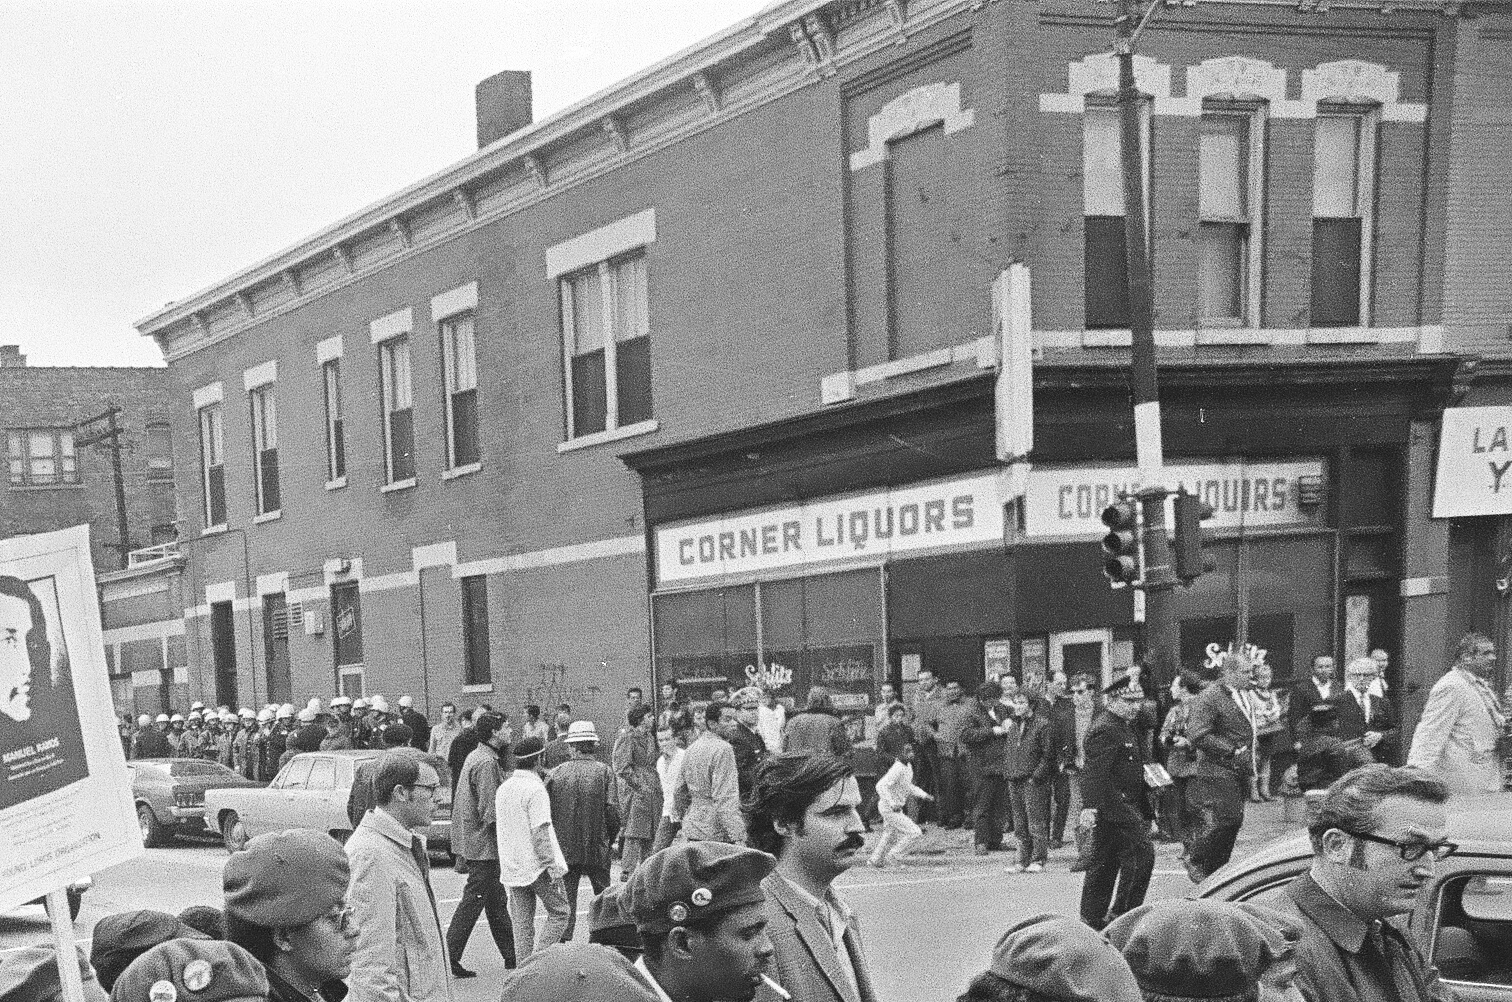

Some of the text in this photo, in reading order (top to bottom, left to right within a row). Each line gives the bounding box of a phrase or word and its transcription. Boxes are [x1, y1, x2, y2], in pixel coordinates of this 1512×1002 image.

[1195, 477, 1288, 513] IQUORS
[678, 494, 975, 566] CORNER LIQUORS
